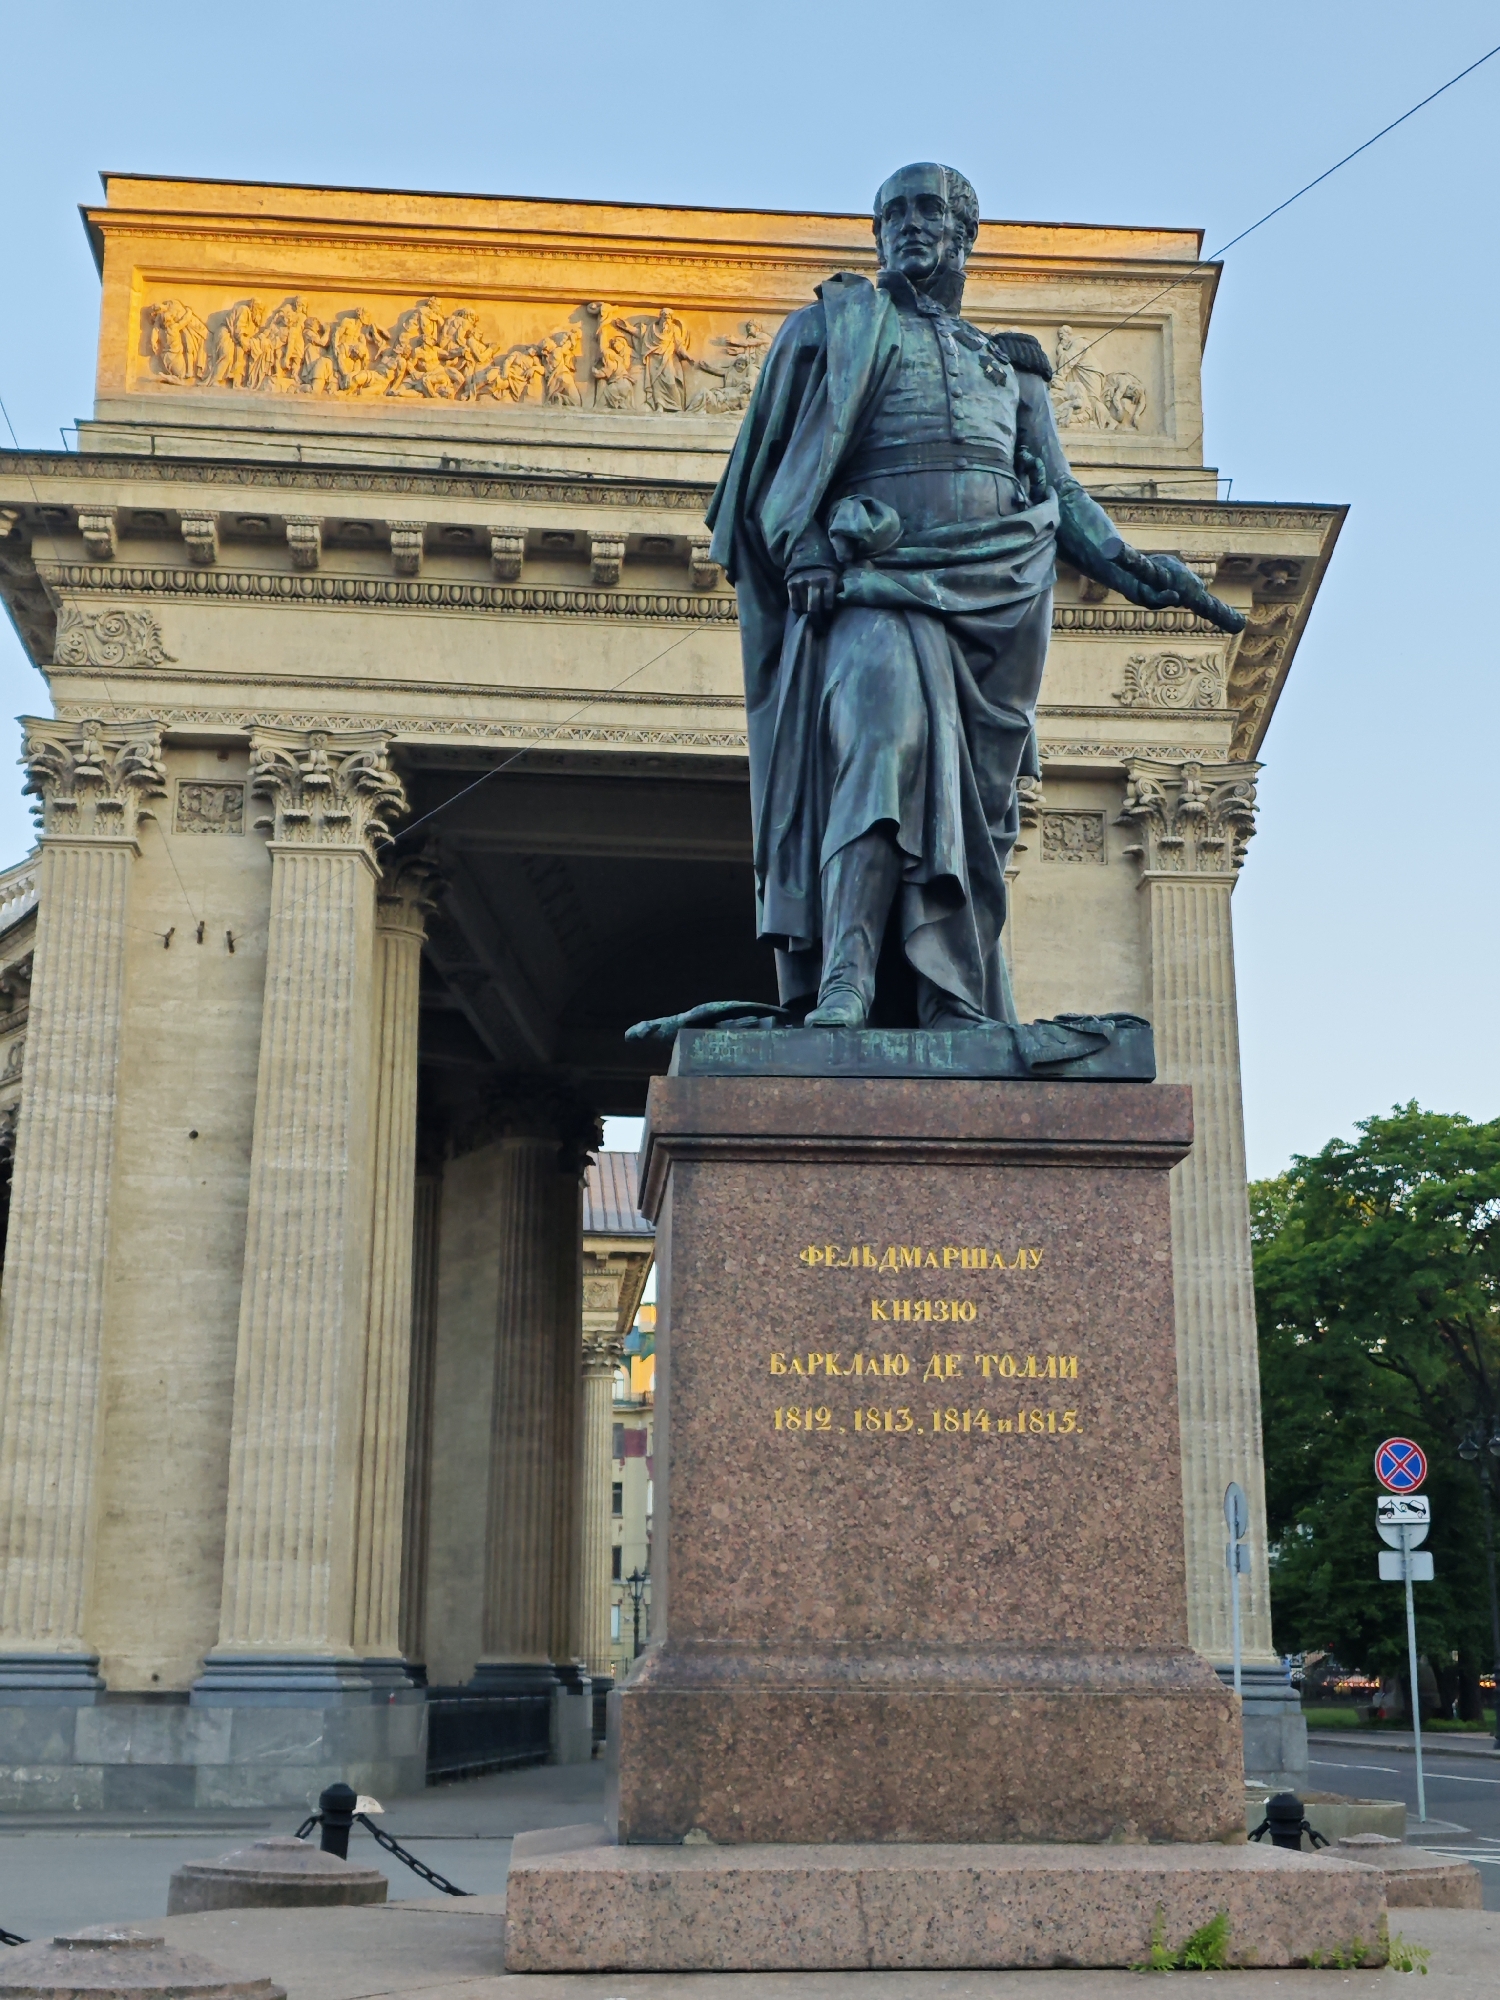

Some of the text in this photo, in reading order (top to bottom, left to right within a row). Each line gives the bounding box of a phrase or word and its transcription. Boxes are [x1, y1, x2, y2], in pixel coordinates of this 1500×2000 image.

[800, 1244, 1045, 1273] ФЕЛЬДМАРШАЛУ
[871, 1298, 978, 1322] КНЯЗЮ
[769, 1352, 1079, 1382] БАРКЛАЮ ДЕ ТОЛЛИ
[932, 1407, 991, 1433] 1814
[1018, 1408, 1084, 1434] 1815.
